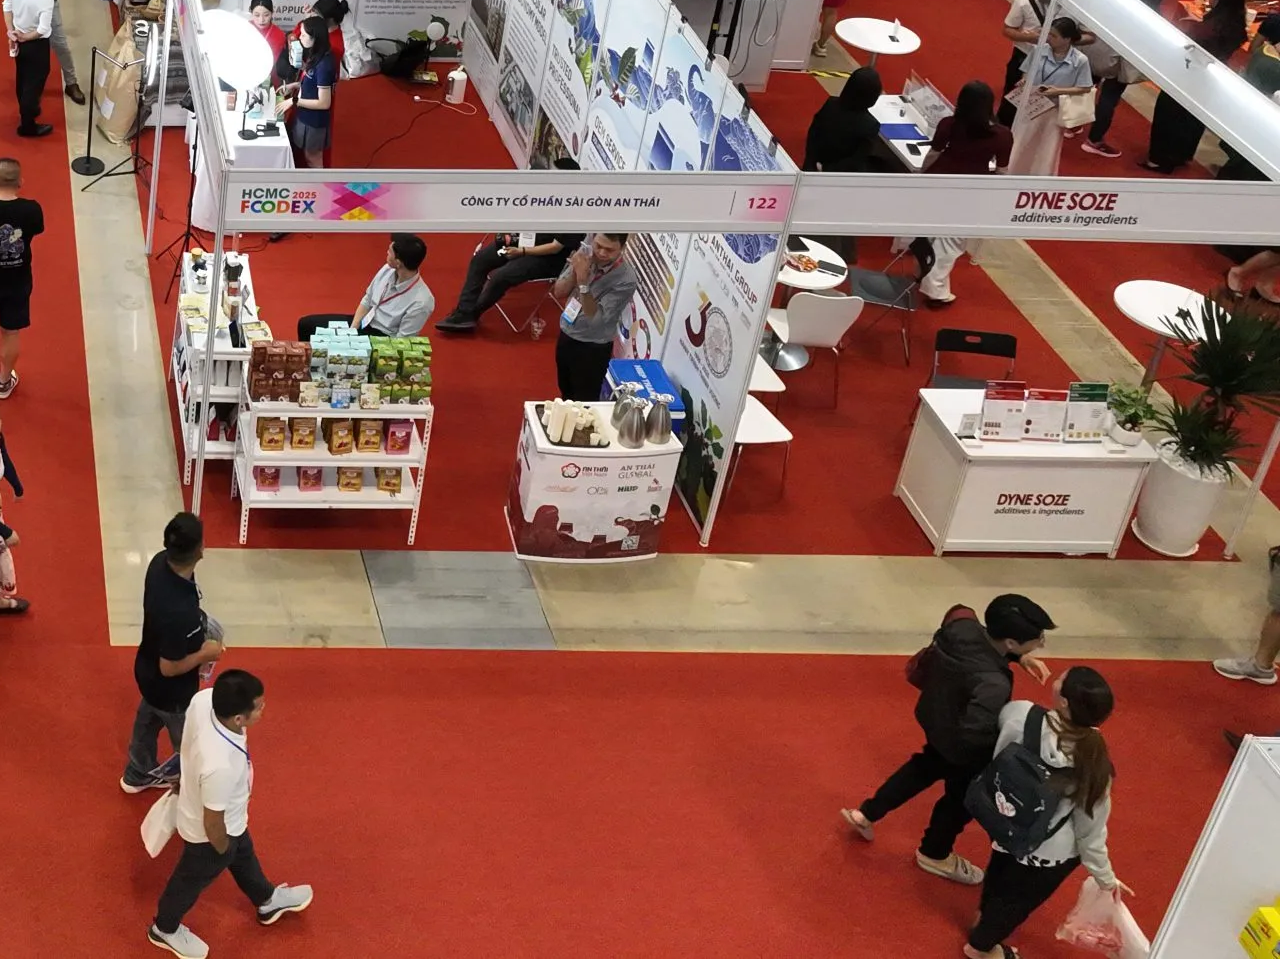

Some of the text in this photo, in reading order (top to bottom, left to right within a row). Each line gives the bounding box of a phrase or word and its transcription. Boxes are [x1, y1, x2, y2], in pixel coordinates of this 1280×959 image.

[242, 188, 317, 199] HCMC 2025
[1015, 191, 1118, 211] DYNE SOZE
[460, 195, 494, 207] CÔNG
[496, 196, 509, 207] TY
[512, 194, 528, 207] CỔ
[565, 195, 584, 208] SÀI
[586, 195, 612, 208] GÒN
[613, 197, 631, 208] AN
[633, 196, 660, 208] THÁI
[747, 197, 777, 210] 122
[1011, 212, 1138, 227] additives ingredients
[711, 234, 759, 305] ANTHAI GROUP
[997, 493, 1071, 506] DYNE SOZE
[994, 507, 1085, 516] additives ingredients
